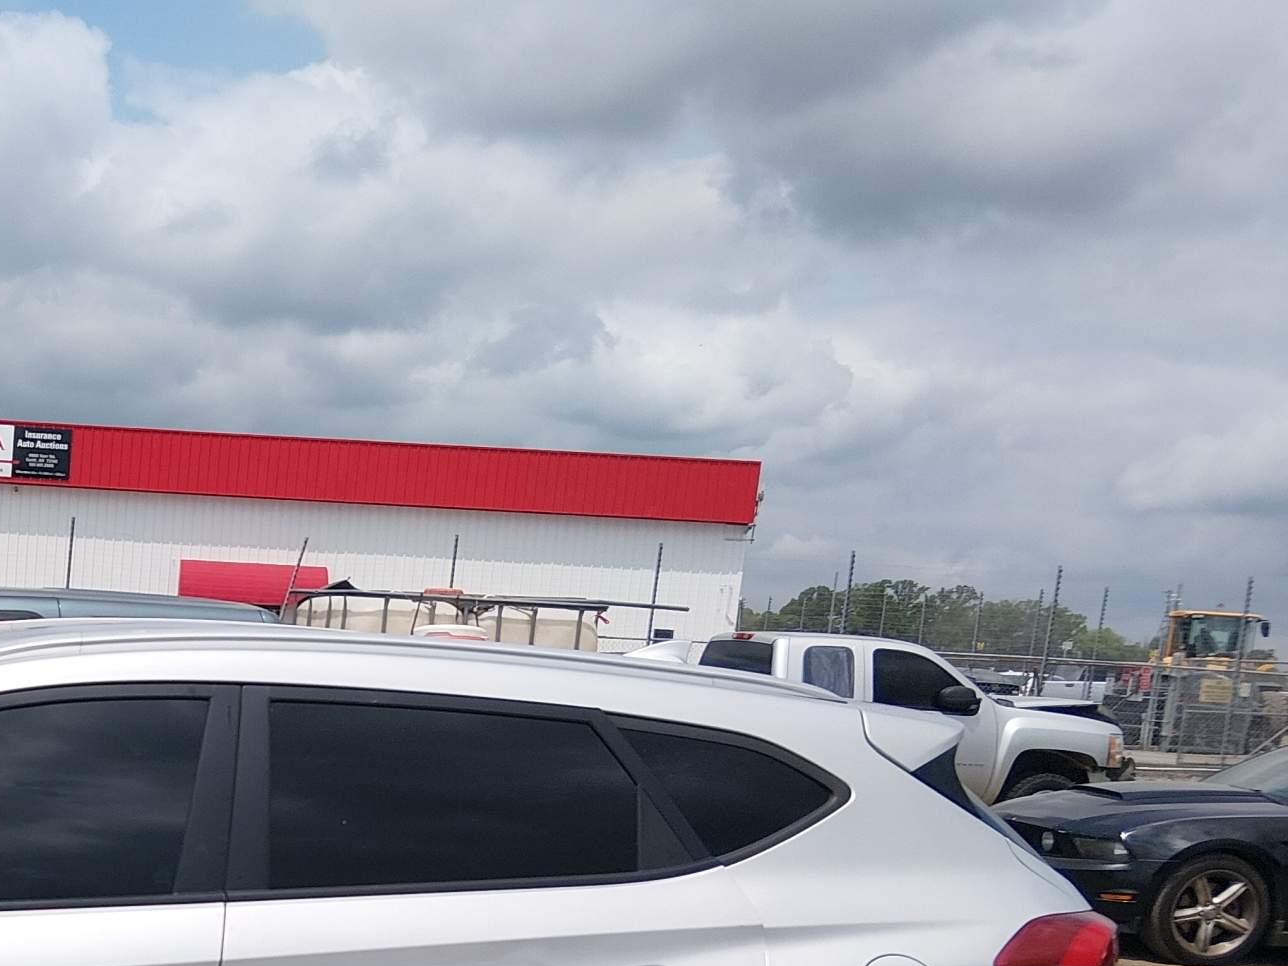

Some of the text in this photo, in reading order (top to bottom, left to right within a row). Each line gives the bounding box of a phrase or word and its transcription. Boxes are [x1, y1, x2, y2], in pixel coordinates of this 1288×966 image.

[25, 430, 62, 441] Insurance
[17, 439, 68, 450] Auto Auctions
